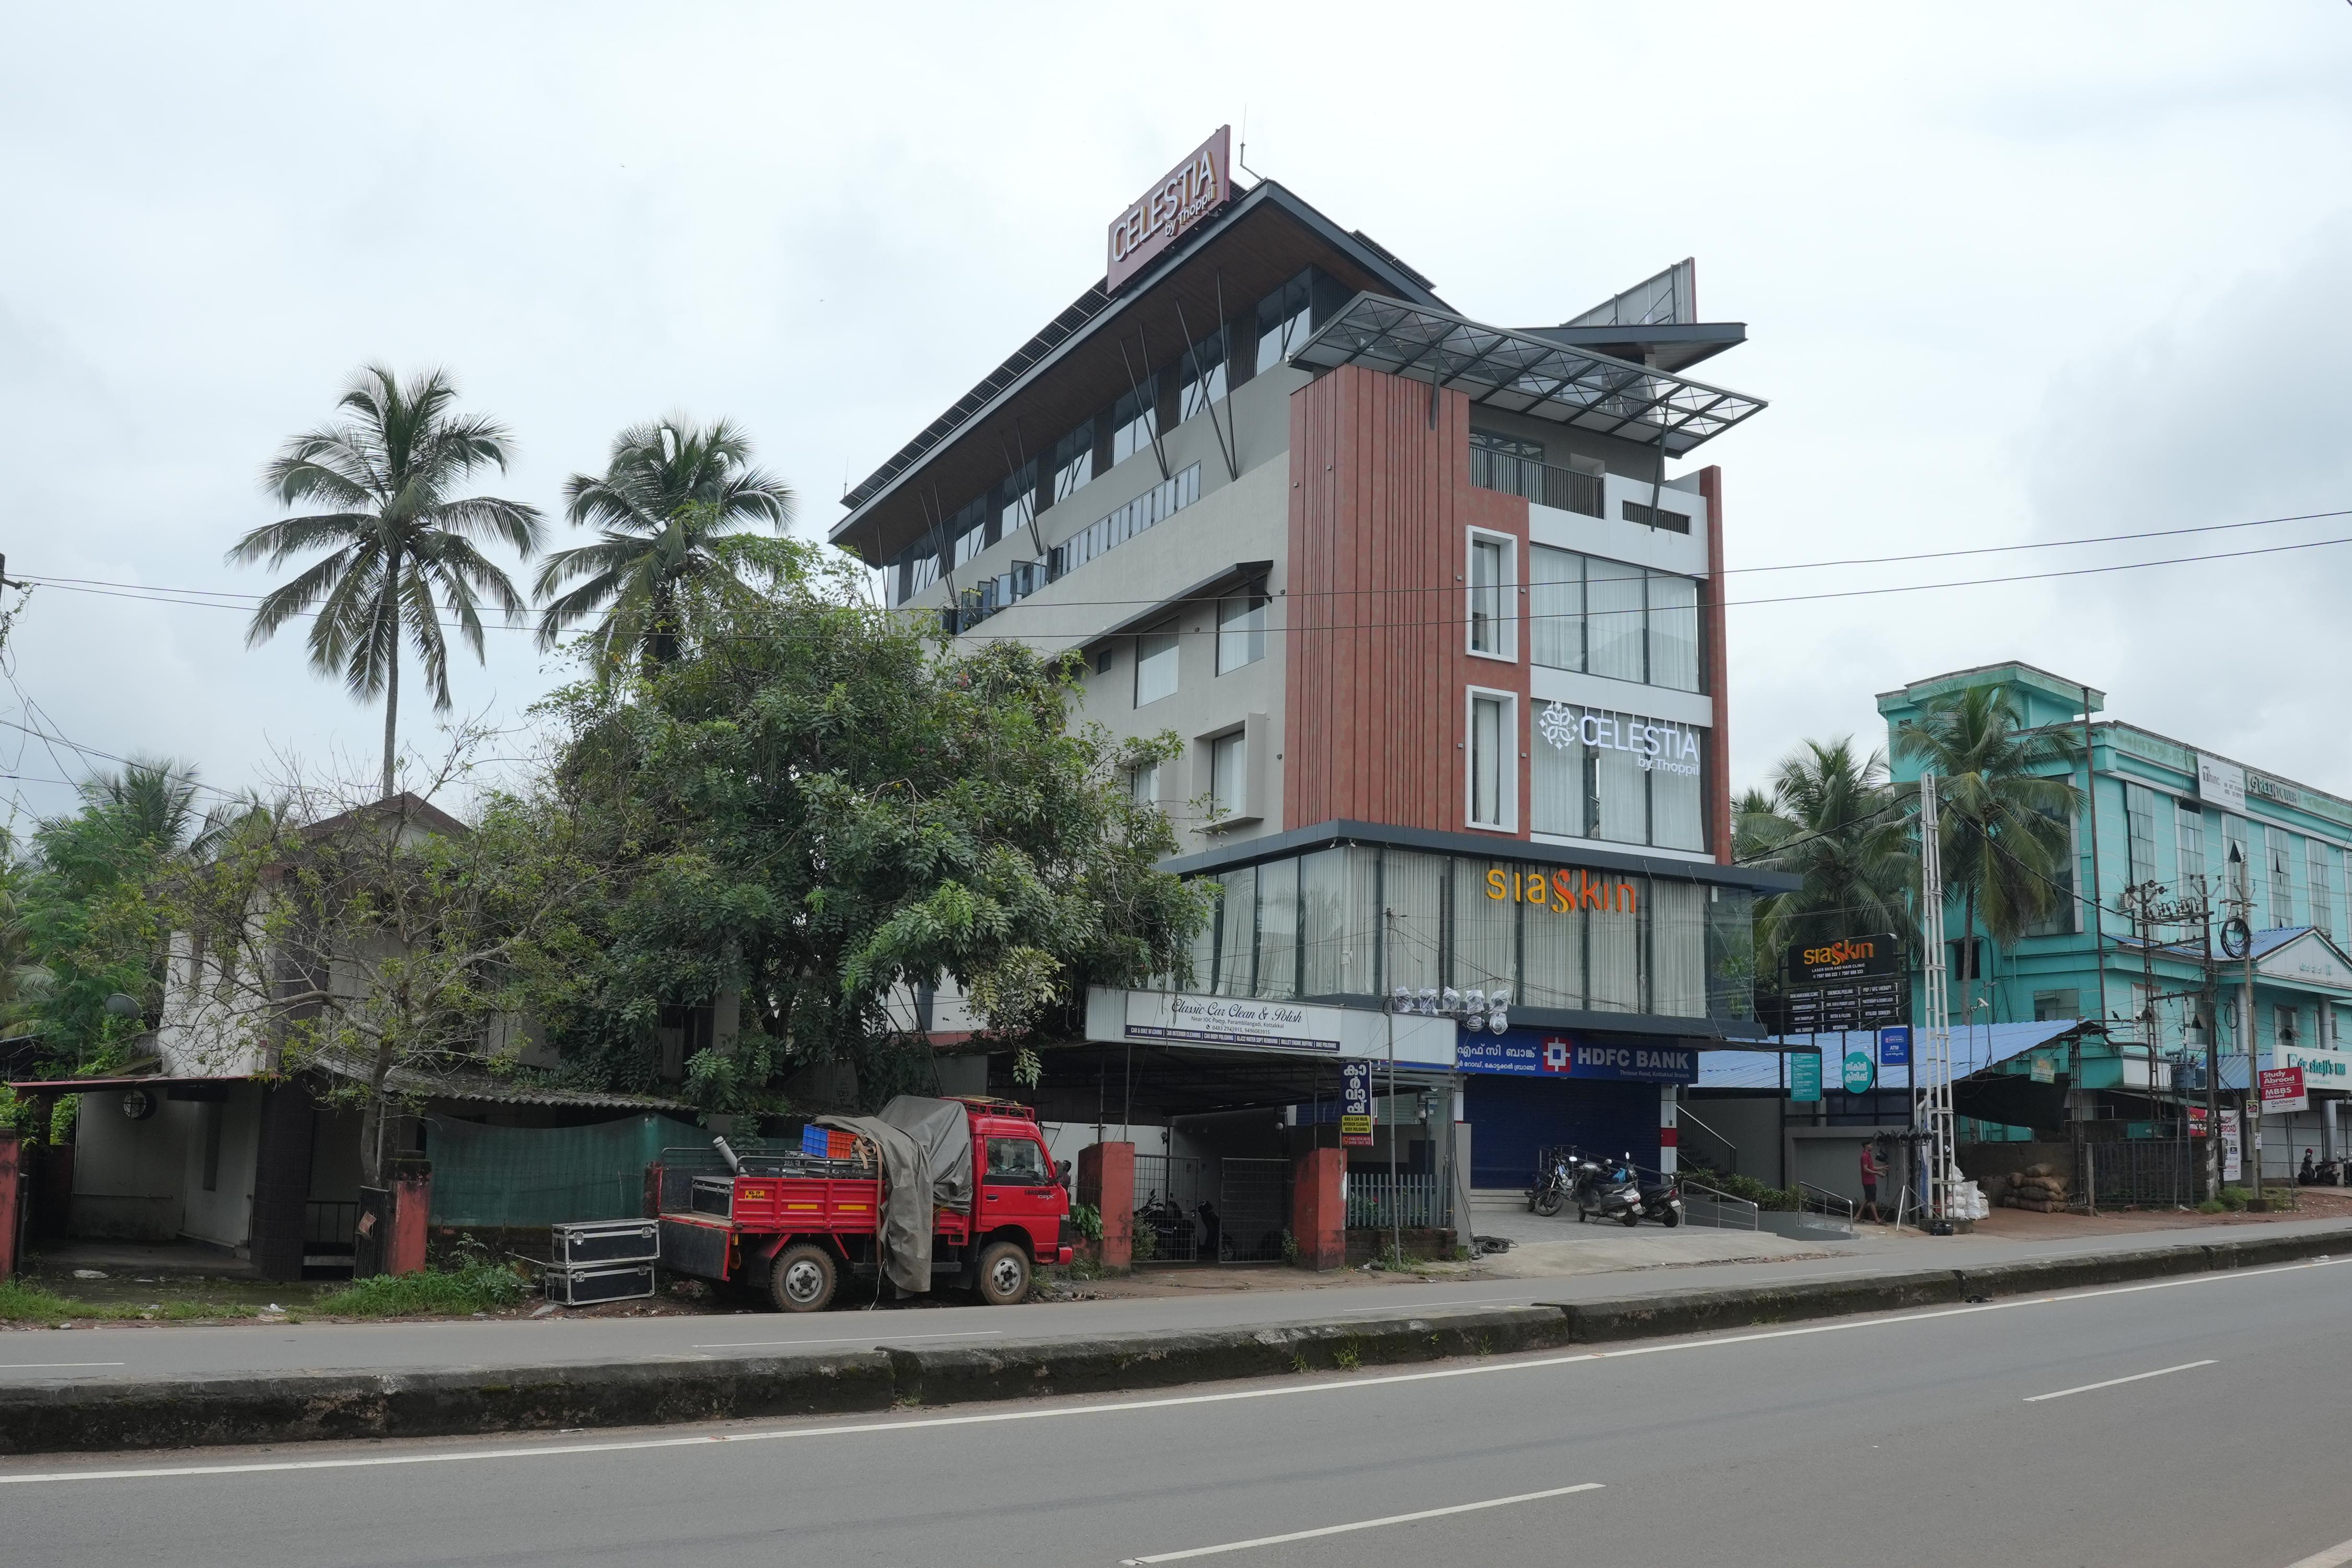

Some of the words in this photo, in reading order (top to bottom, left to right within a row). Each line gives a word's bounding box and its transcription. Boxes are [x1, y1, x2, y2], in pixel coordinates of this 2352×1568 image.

[1113, 150, 1215, 261] CELESTIA
[1165, 220, 1178, 236] by
[1178, 185, 1217, 225] Thoppil
[1580, 715, 1699, 762] CELESTIA
[1638, 755, 1652, 771] by
[1656, 758, 1699, 777] Thoppil
[1172, 998, 1204, 1013] Classic
[1208, 1002, 1226, 1016] Car
[1229, 1004, 1255, 1019] Clean
[1259, 1007, 1268, 1020] &
[1272, 1008, 1302, 1023] Polish
[1578, 1047, 1630, 1067] HDFC
[1636, 1051, 1689, 1069] BANK
[2264, 1075, 2295, 1084] Abroad
[2335, 1063, 2346, 1076] MRI
[2265, 1087, 2292, 1096] MBBS
